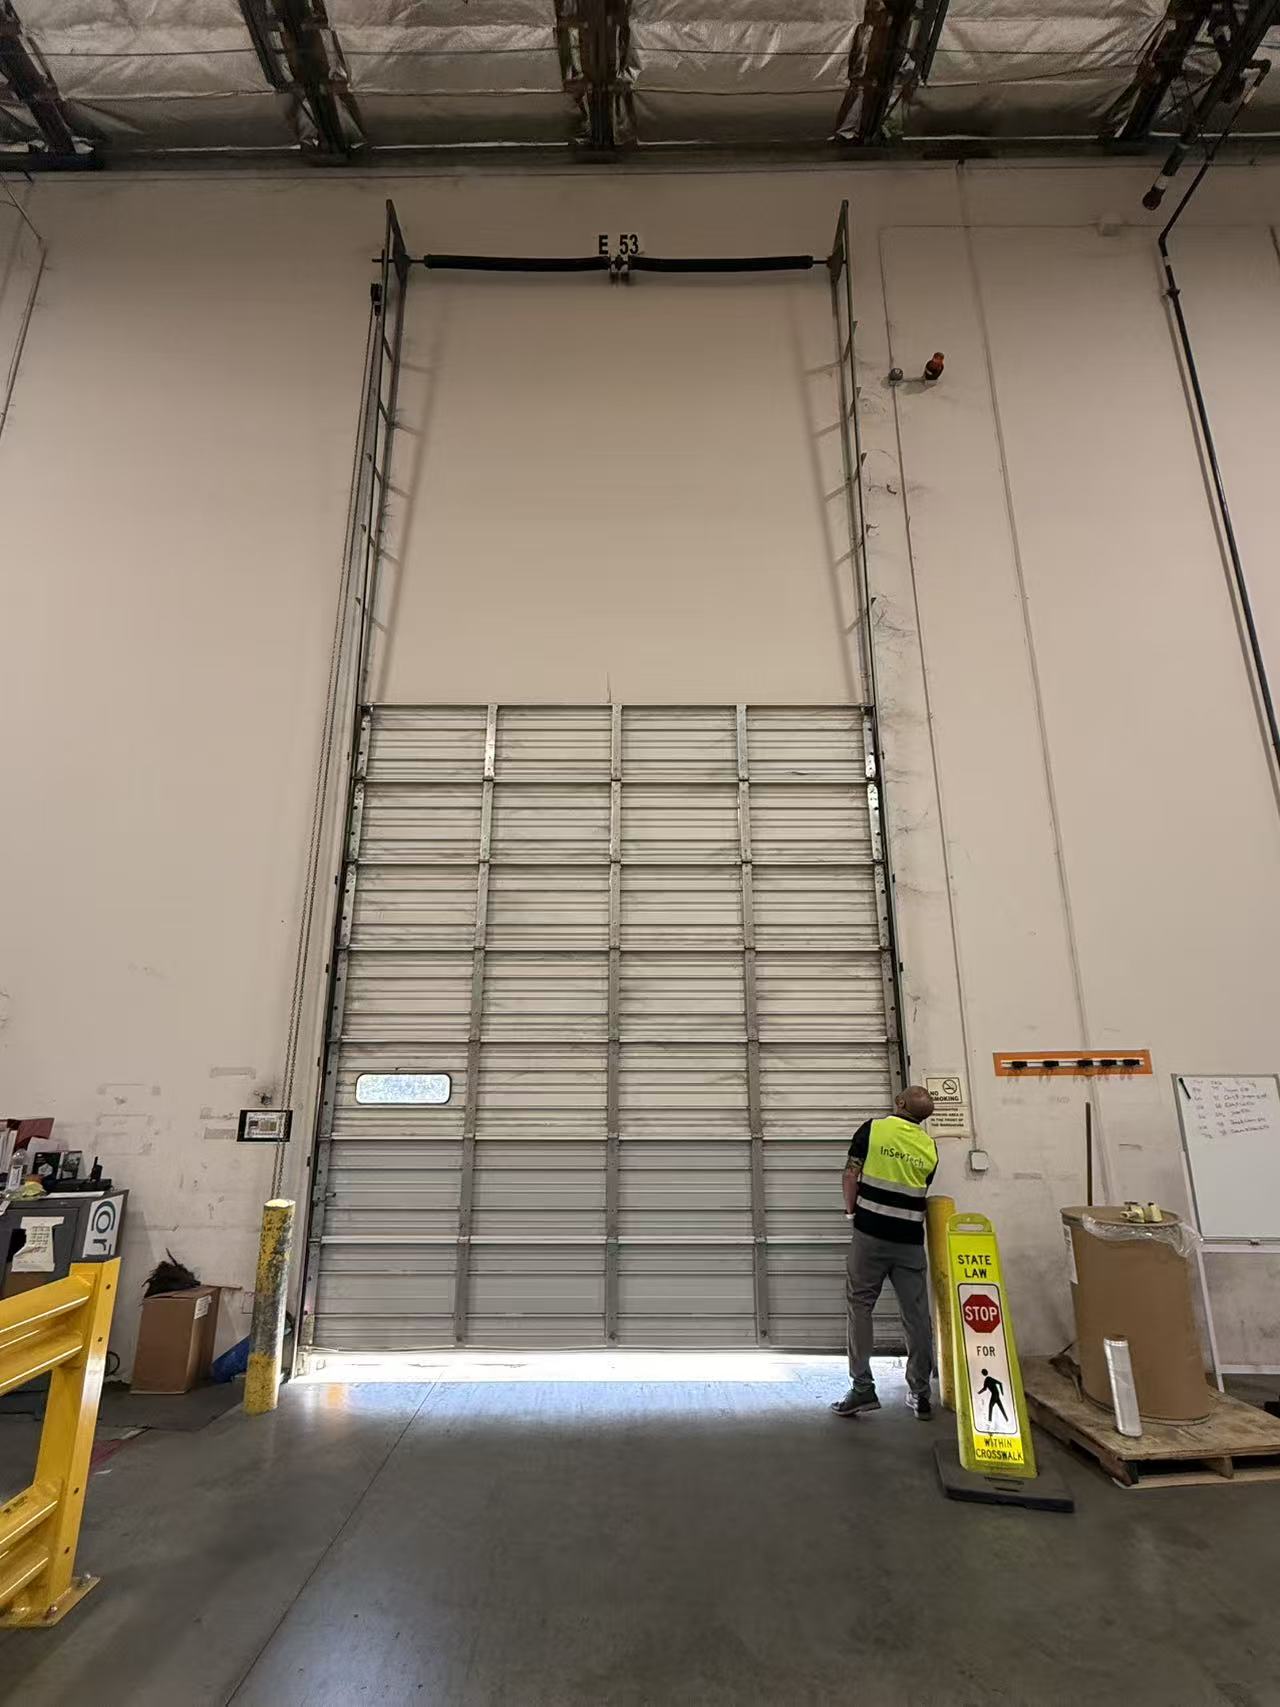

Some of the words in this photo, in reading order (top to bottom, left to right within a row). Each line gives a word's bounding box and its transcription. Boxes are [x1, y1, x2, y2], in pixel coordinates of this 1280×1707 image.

[598, 234, 609, 255] E
[619, 233, 639, 255] 53
[957, 1254, 992, 1266] STATE
[964, 1268, 987, 1279] LAW
[964, 1305, 998, 1321] STOP
[976, 1345, 996, 1357] FOR
[984, 1437, 1012, 1448] WITHIN
[975, 1448, 1024, 1461] CROSSWALK
